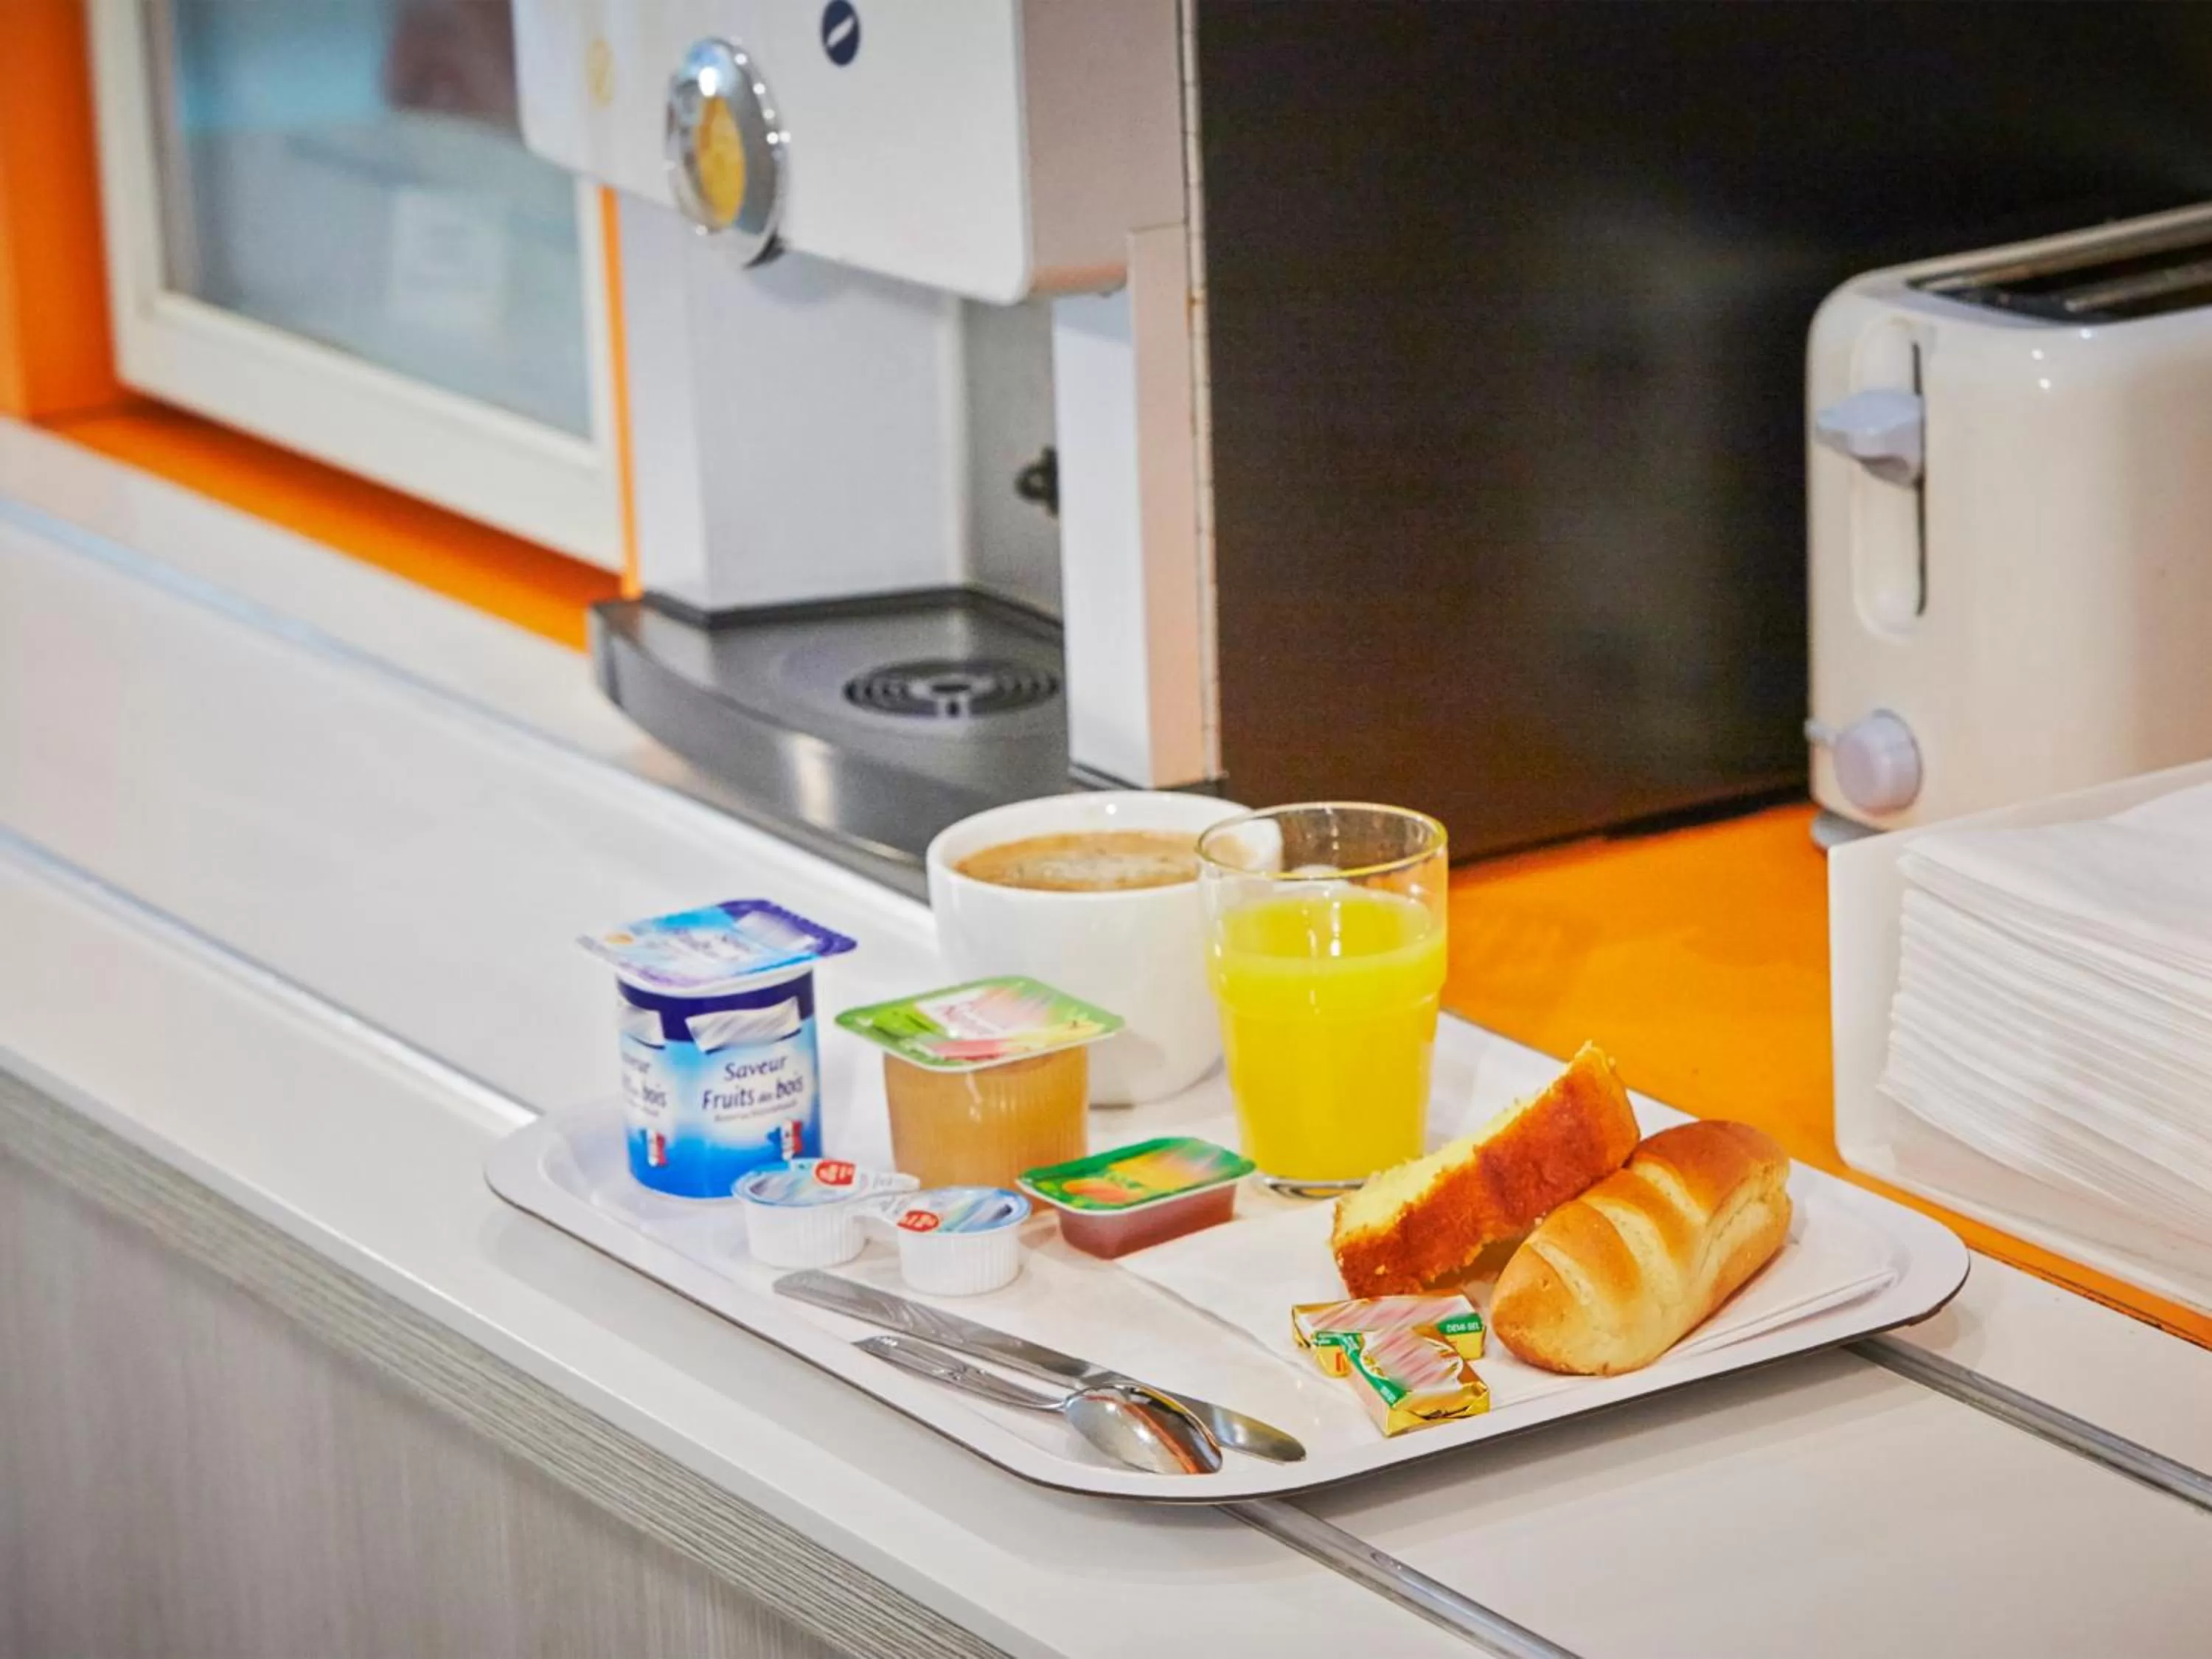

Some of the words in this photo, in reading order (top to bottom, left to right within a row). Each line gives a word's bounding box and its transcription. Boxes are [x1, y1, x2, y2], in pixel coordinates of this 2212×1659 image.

[725, 1055, 787, 1079] Saveur
[702, 1085, 755, 1109] Fruits
[774, 1071, 804, 1099] bois
